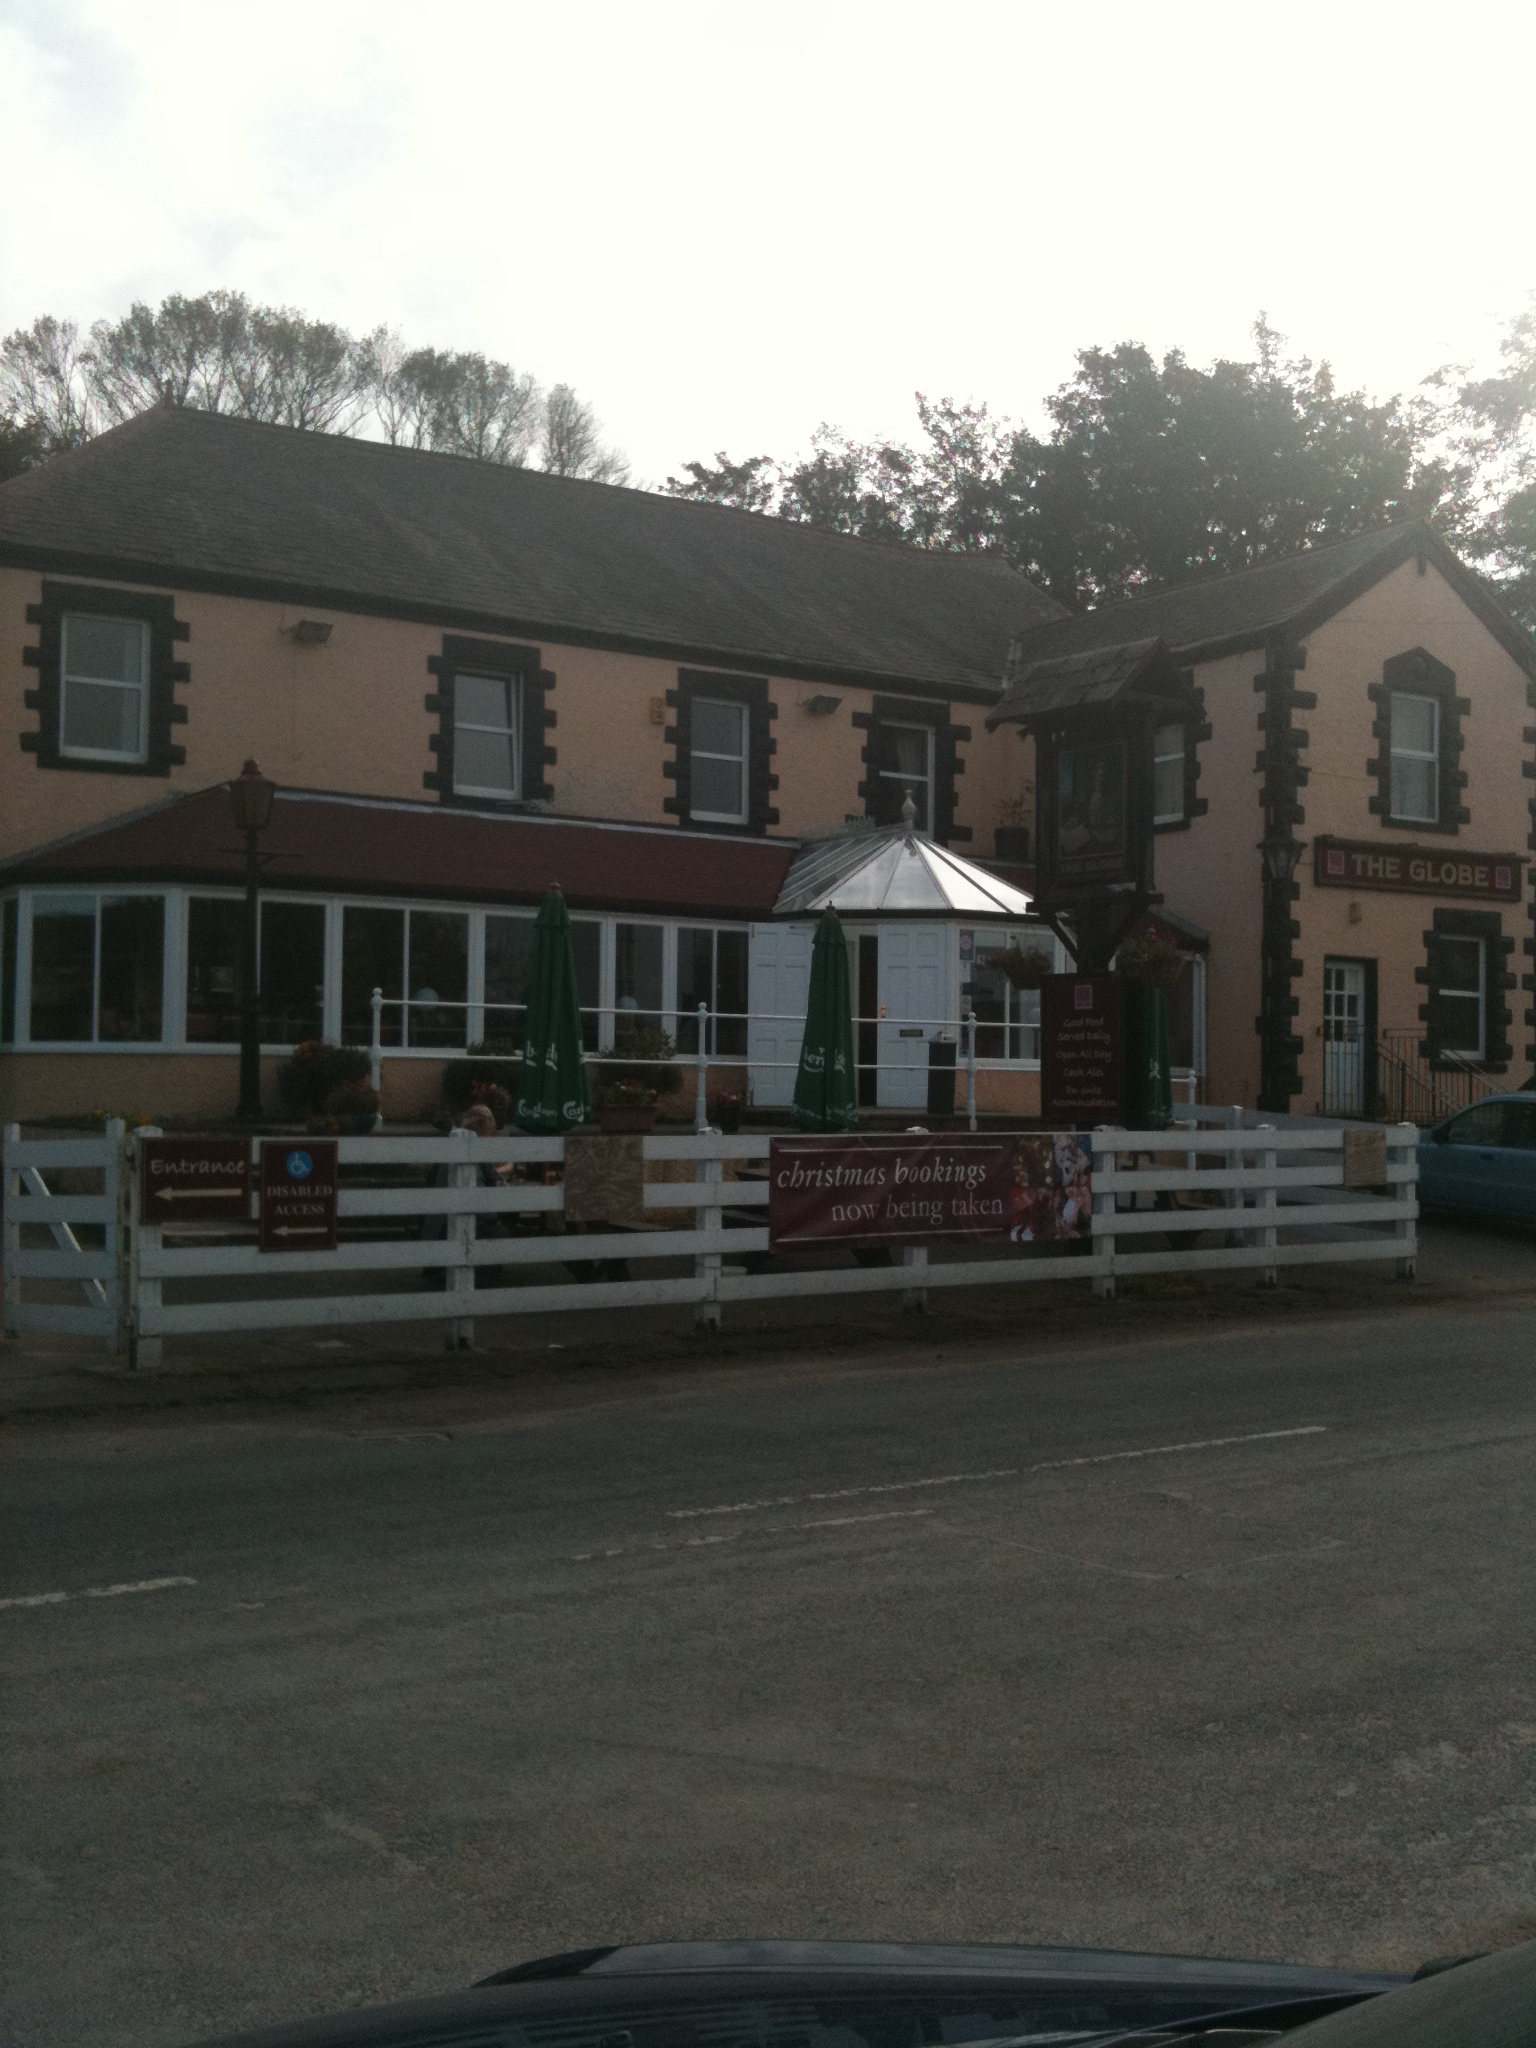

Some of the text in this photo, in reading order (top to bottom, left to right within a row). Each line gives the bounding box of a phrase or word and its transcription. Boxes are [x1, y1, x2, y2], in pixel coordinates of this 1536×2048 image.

[1351, 853, 1489, 887] THE GLOBE
[1085, 1016, 1105, 1027] Food
[1056, 1032, 1085, 1041] Served
[150, 1158, 246, 1175] Entrance
[777, 1157, 986, 1190] christmas bookings
[266, 1185, 333, 1198] DISABLED
[274, 1203, 326, 1216] ACCESS
[831, 1191, 1003, 1225] now being taken
